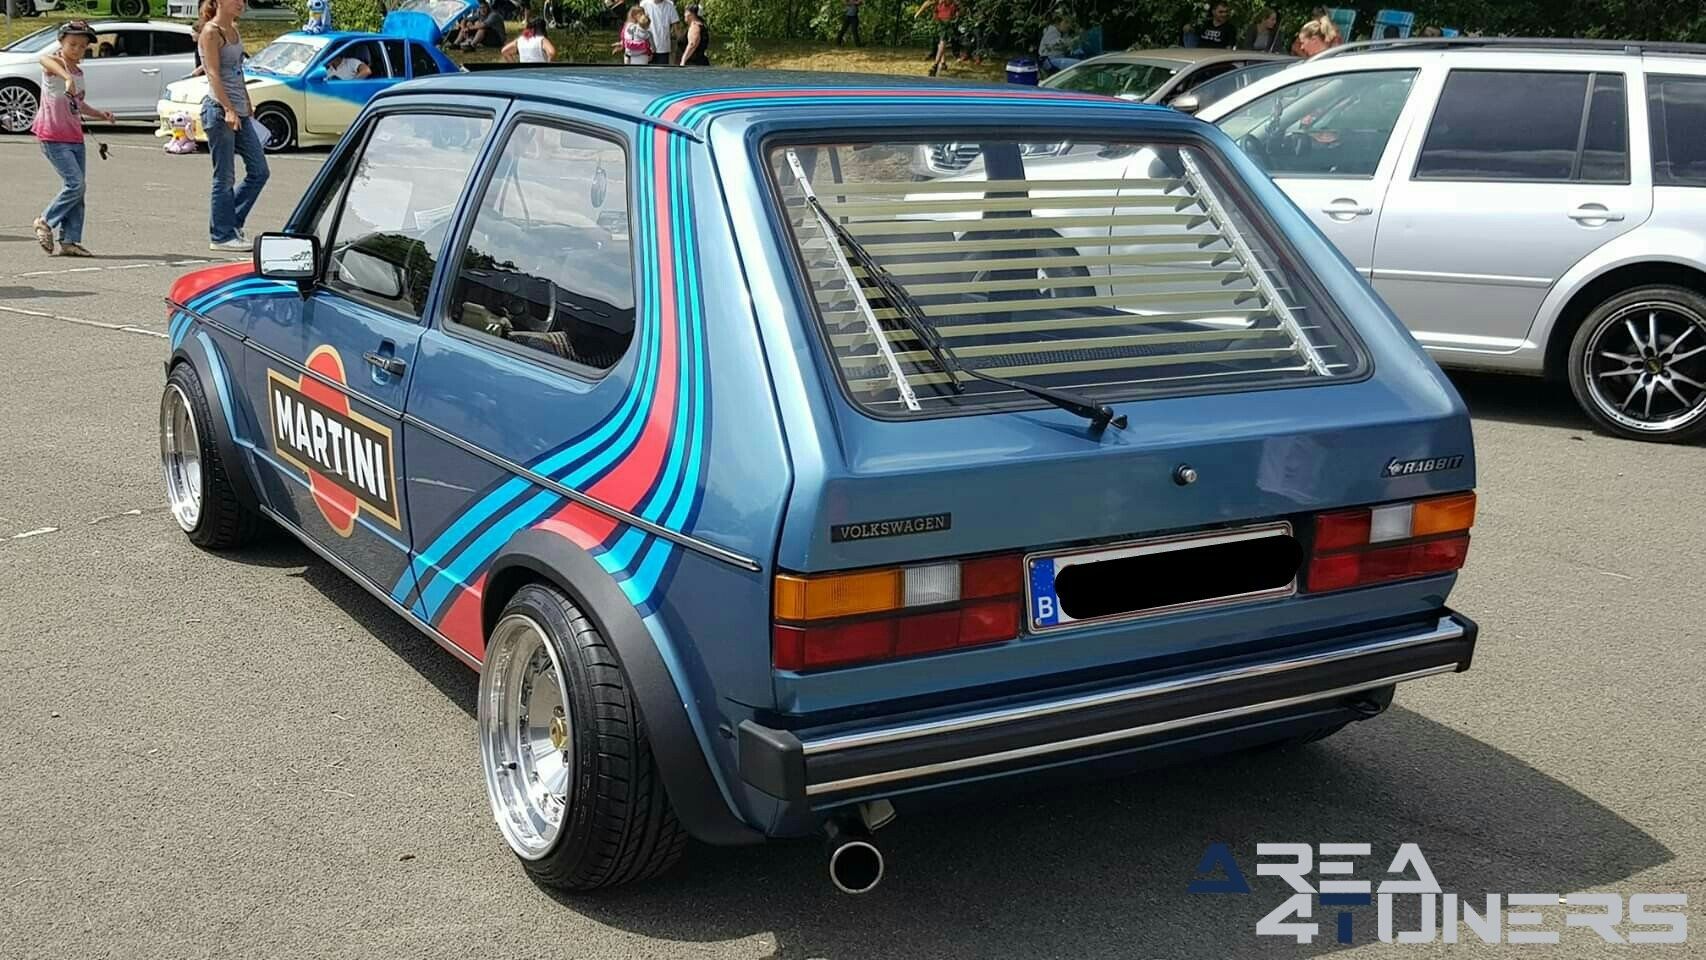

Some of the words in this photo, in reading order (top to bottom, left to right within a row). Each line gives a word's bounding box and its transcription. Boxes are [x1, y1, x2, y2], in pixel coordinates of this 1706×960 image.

[275, 390, 388, 501] MARTINI
[1403, 456, 1462, 473] RABBIT
[839, 514, 944, 538] VOLKSWAGEN
[1038, 597, 1053, 619] B
